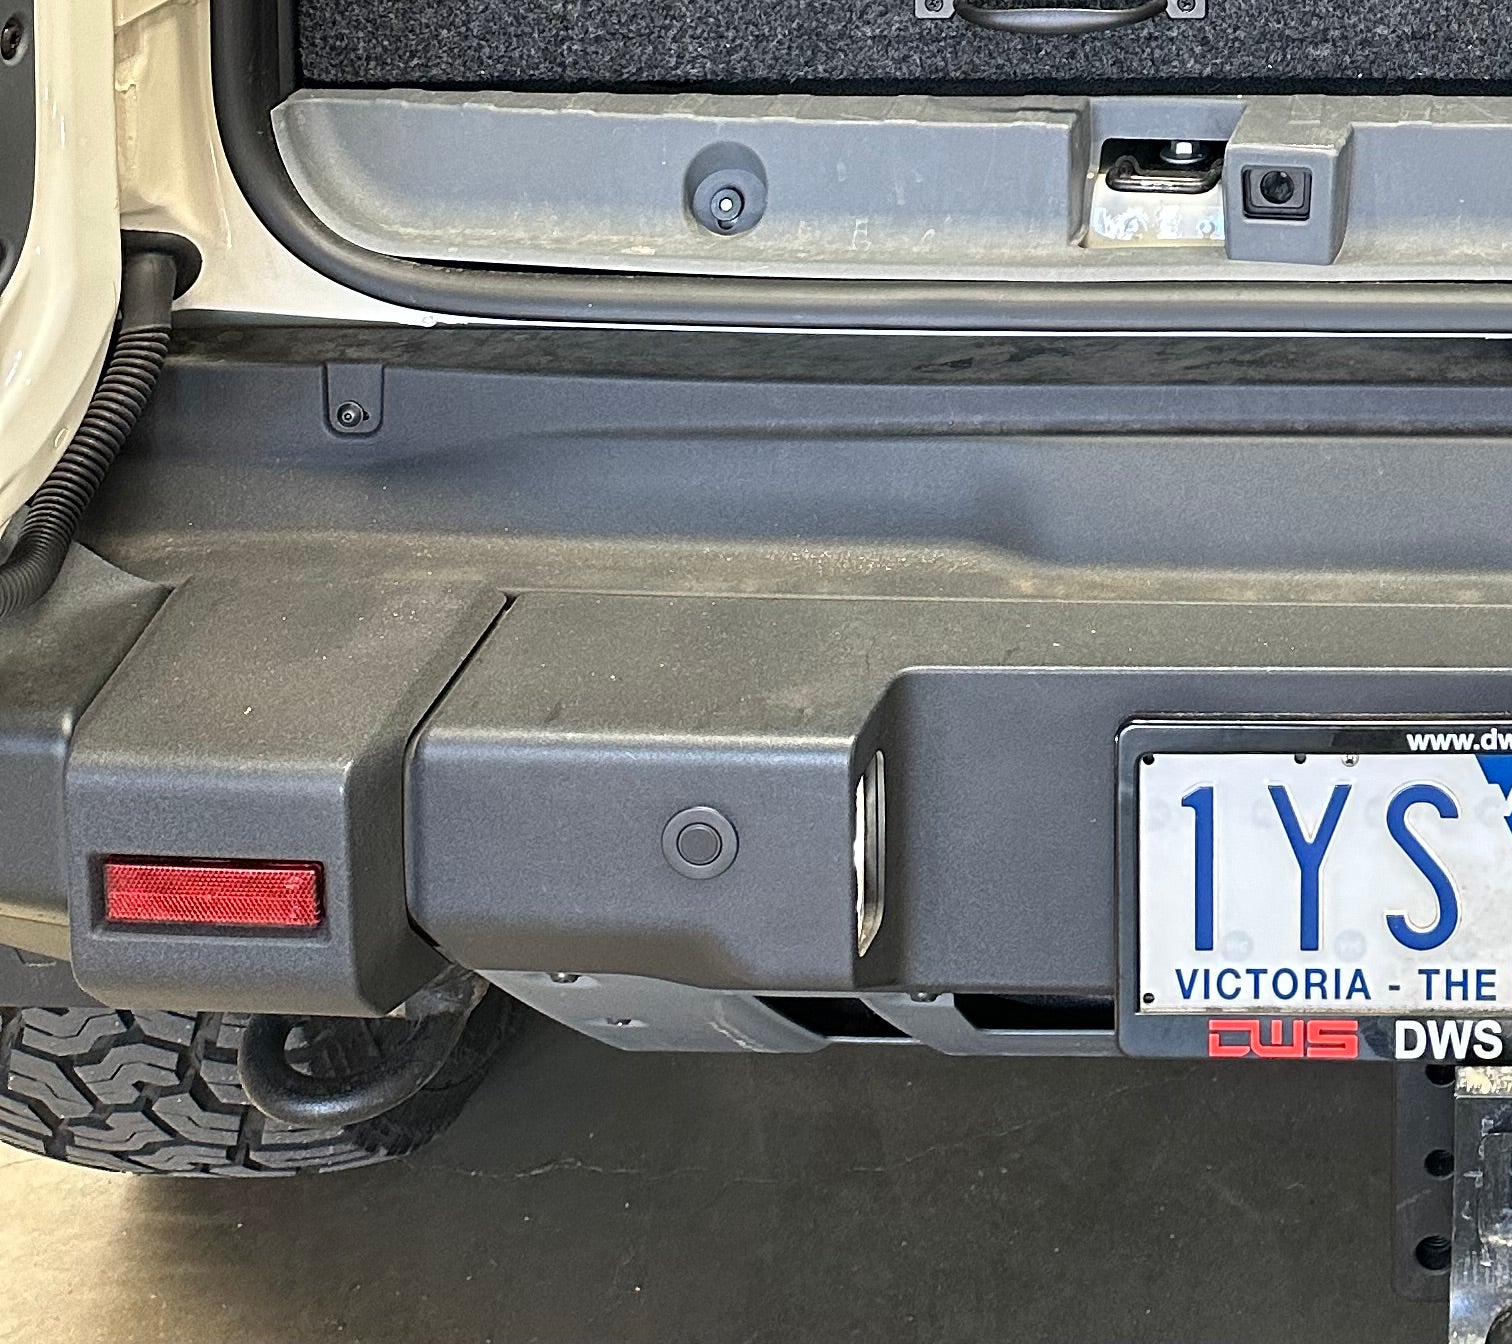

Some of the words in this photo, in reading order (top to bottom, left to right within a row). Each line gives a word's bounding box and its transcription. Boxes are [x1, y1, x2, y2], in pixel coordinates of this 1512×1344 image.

[1181, 783, 1460, 952] 1YS
[1175, 968, 1371, 1000] VICTORIA
[1418, 969, 1497, 1001] THE
[1208, 1019, 1360, 1059] DWS
[1394, 1019, 1504, 1060] DWS
